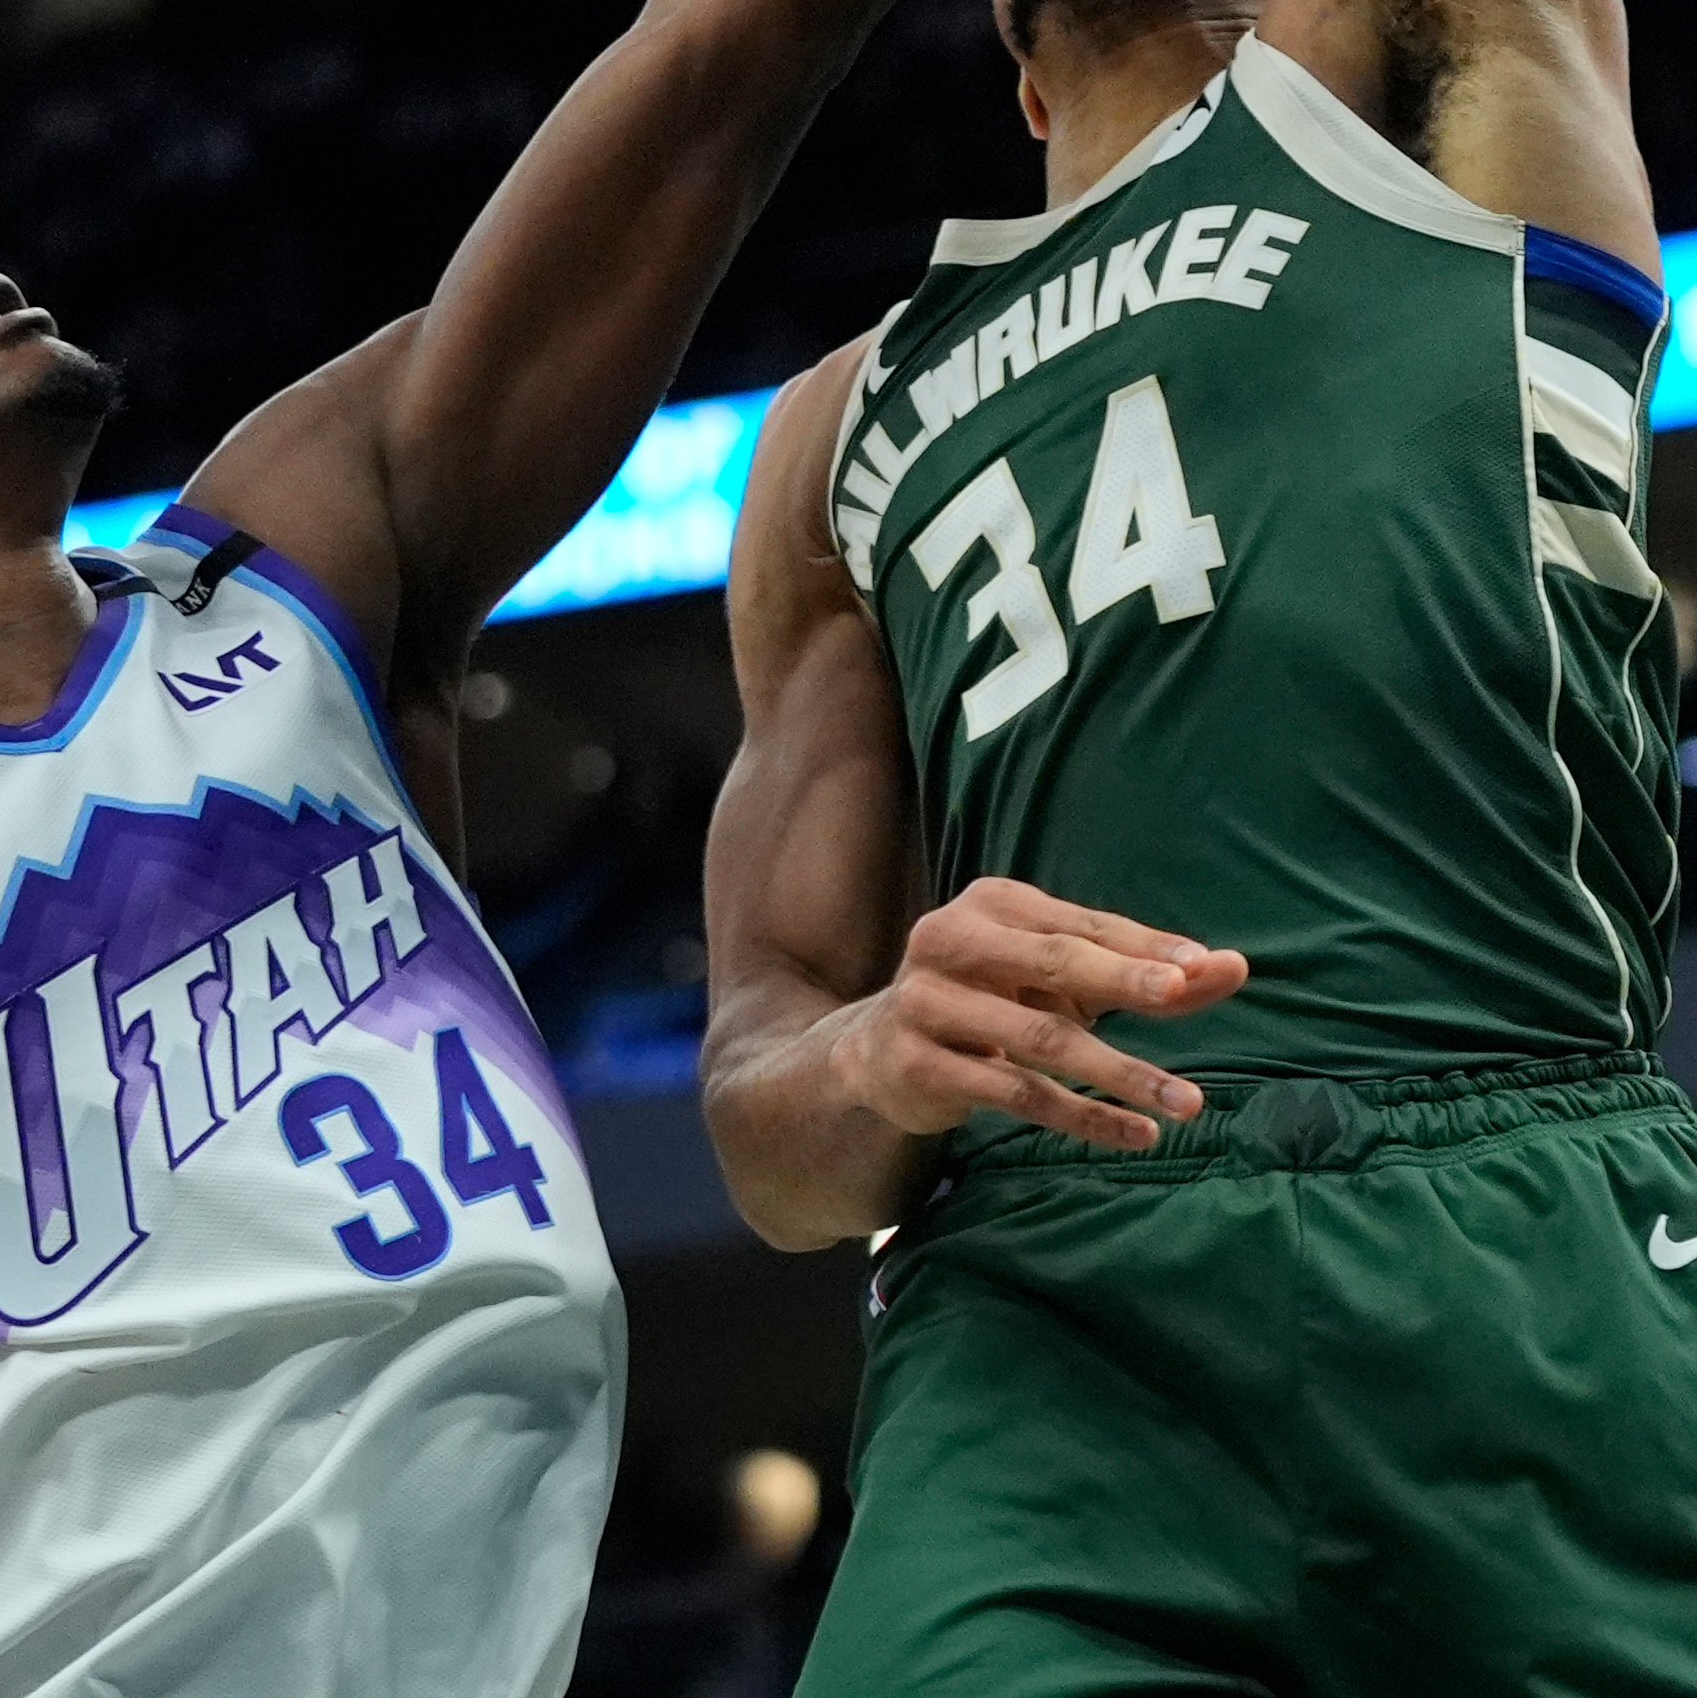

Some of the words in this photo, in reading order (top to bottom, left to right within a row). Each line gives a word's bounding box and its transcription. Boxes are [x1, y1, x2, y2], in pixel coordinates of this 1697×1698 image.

[836, 205, 1310, 591] MILWAUKEE
[909, 374, 1227, 742] 34
[278, 1027, 555, 1281] 34
